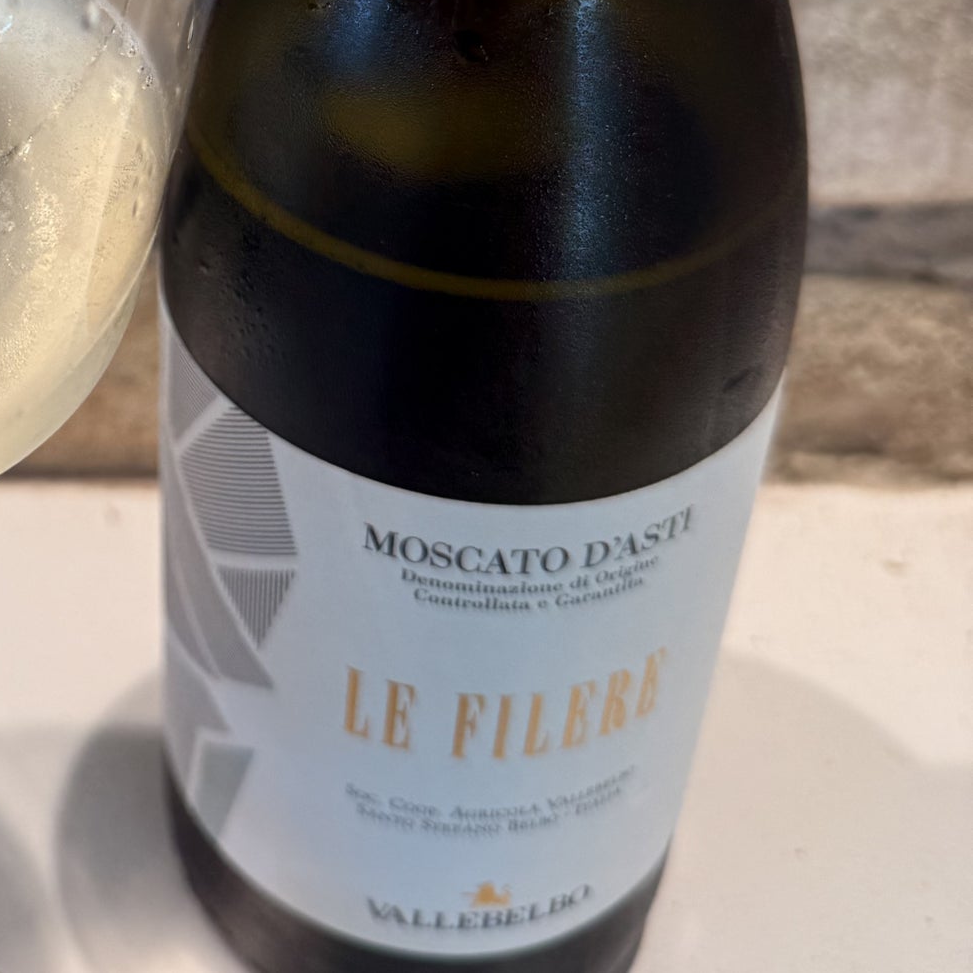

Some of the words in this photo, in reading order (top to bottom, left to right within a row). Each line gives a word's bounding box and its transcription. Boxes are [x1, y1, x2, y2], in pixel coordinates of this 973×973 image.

[363, 522, 570, 575] MOSCATO
[582, 504, 695, 568] D'ASTI
[401, 568, 563, 595] Denominazione
[570, 576, 590, 591] di
[414, 588, 530, 611] Controllata
[342, 664, 418, 754] LE
[451, 646, 668, 761] FILERE
[367, 884, 592, 930] VALLEBELBO
